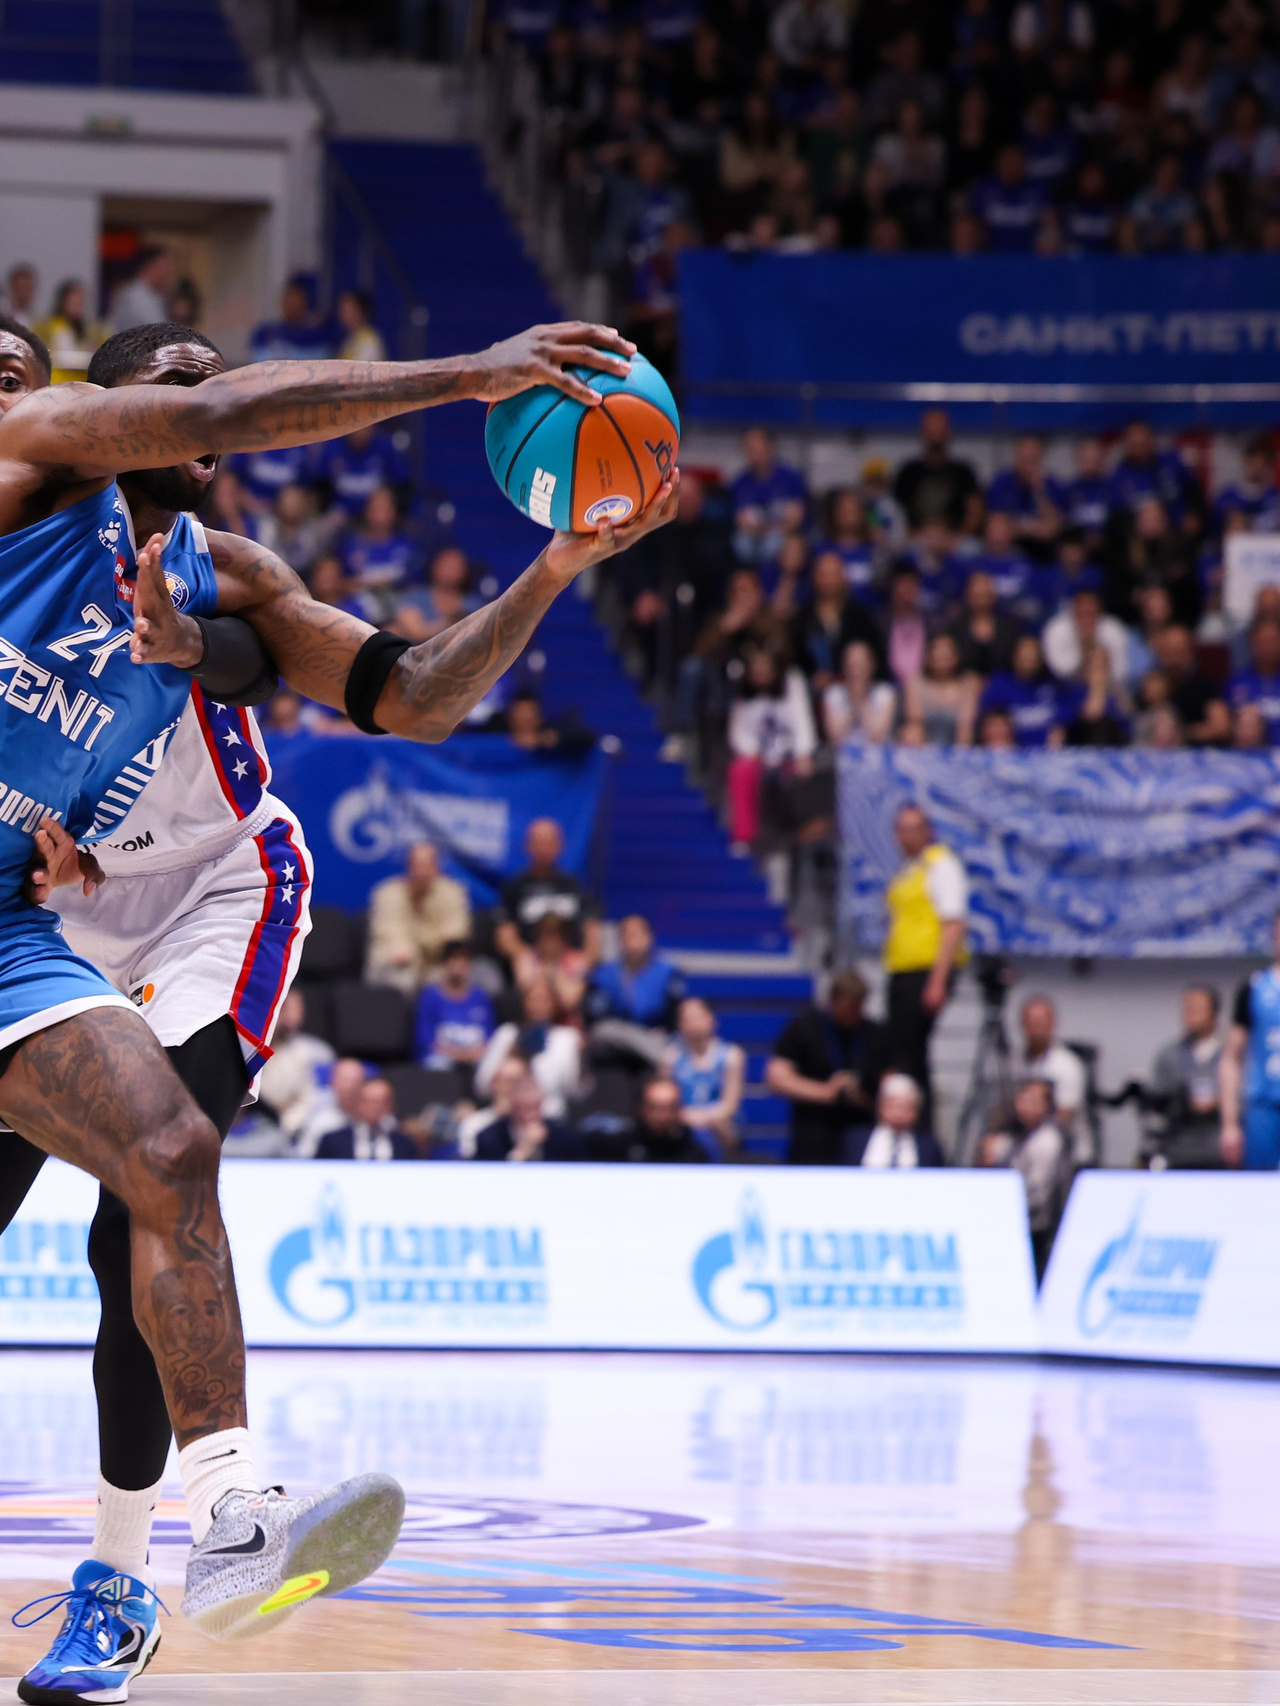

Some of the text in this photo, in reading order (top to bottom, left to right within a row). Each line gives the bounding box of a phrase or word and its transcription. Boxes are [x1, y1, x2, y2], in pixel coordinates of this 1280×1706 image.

[959, 311, 1280, 356] САНКТ-ПЕТ
[359, 1225, 546, 1269] ГАЗПРОМ
[779, 1229, 962, 1273] ГАЗПРОМ
